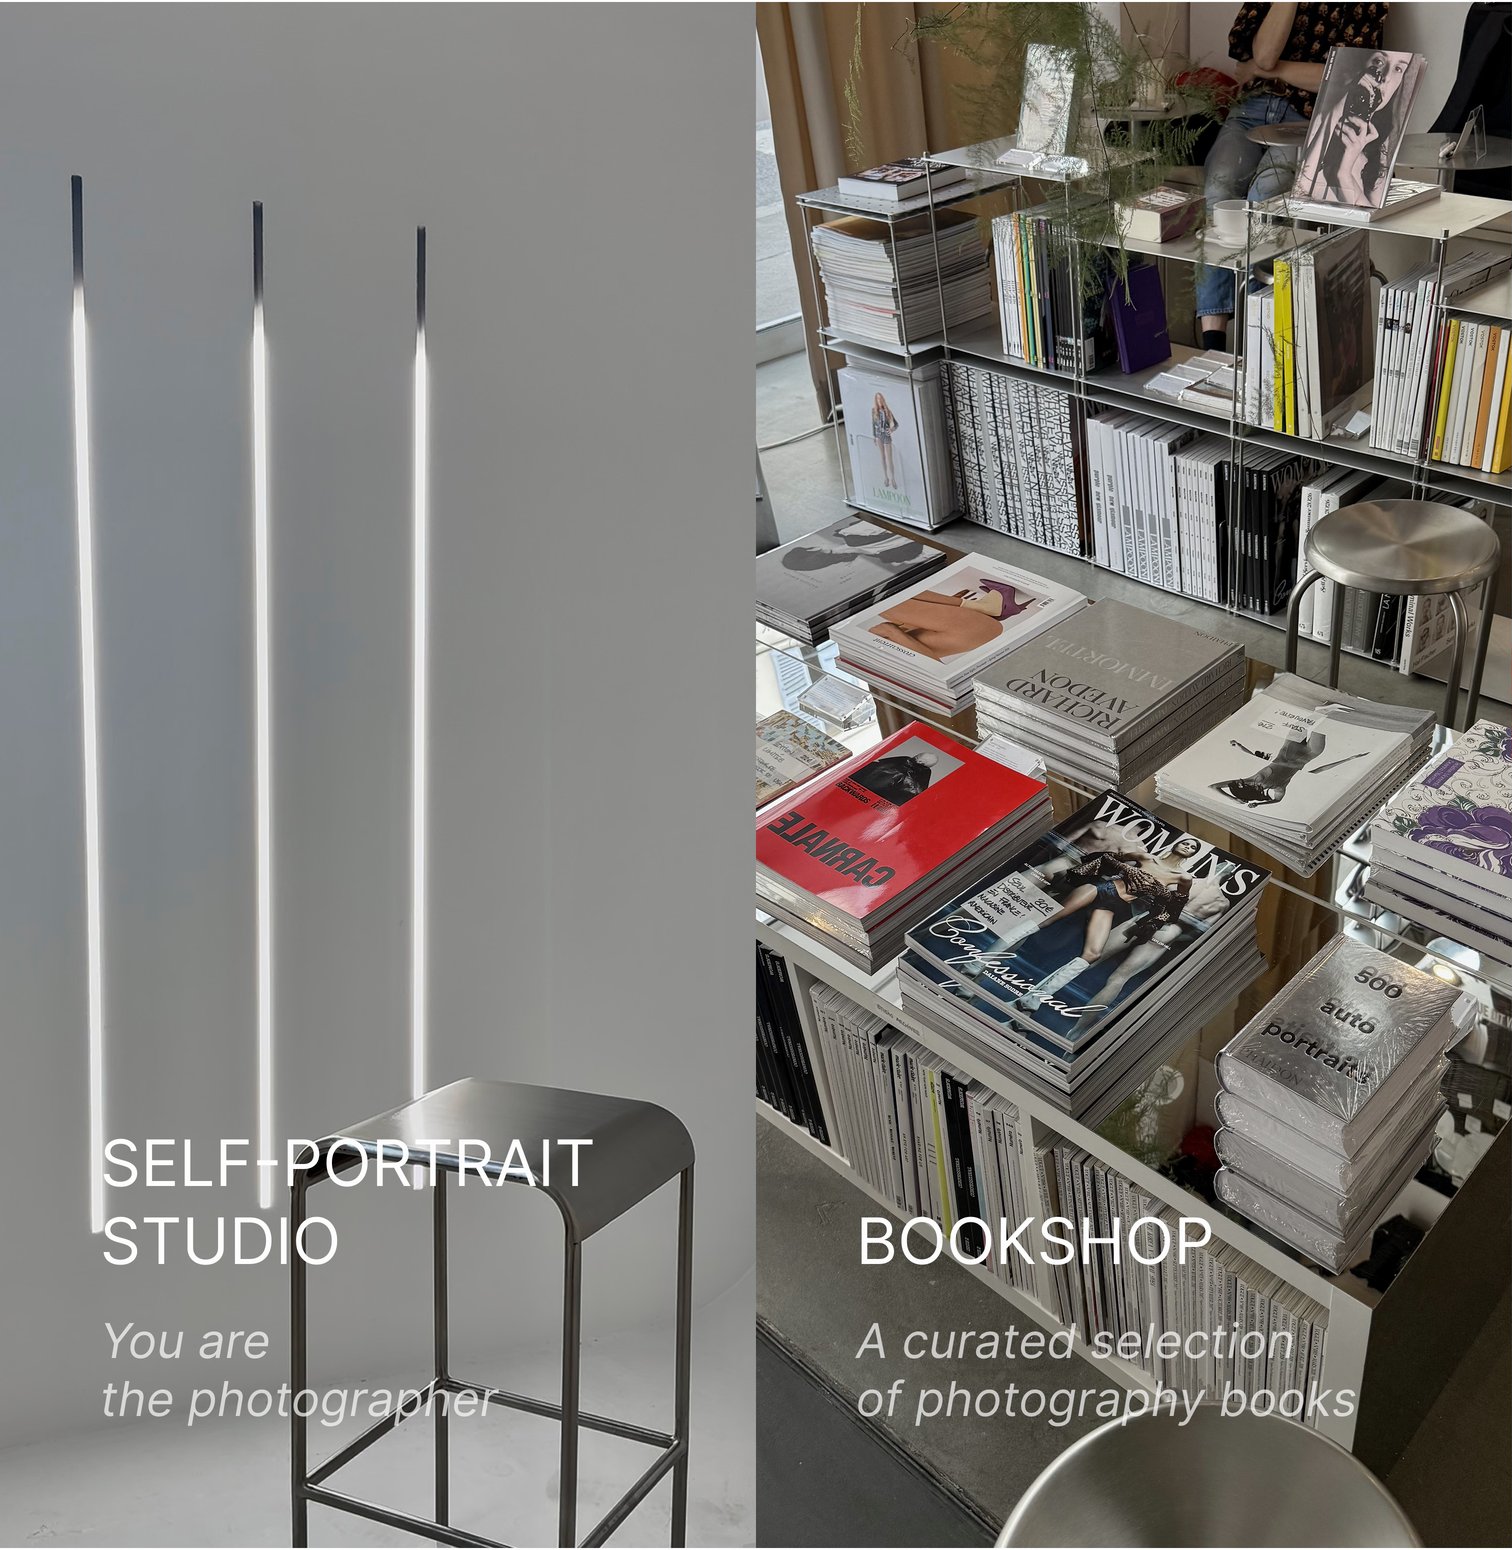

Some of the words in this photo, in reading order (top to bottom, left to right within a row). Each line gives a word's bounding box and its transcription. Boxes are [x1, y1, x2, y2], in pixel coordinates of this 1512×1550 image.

[1490, 332, 1498, 352] VOSTOK
[872, 487, 912, 506] LAMPOON
[1404, 616, 1414, 638] Works
[1006, 678, 1122, 730] RICHARD
[1030, 668, 1140, 714] AVEDON
[835, 781, 871, 804] BACKWARDS
[1093, 794, 1261, 896] WOMN'S
[929, 915, 1108, 1018] Confessional
[1353, 966, 1404, 1000] 500
[1320, 999, 1377, 1036] auto
[1260, 1020, 1371, 1086] portraits
